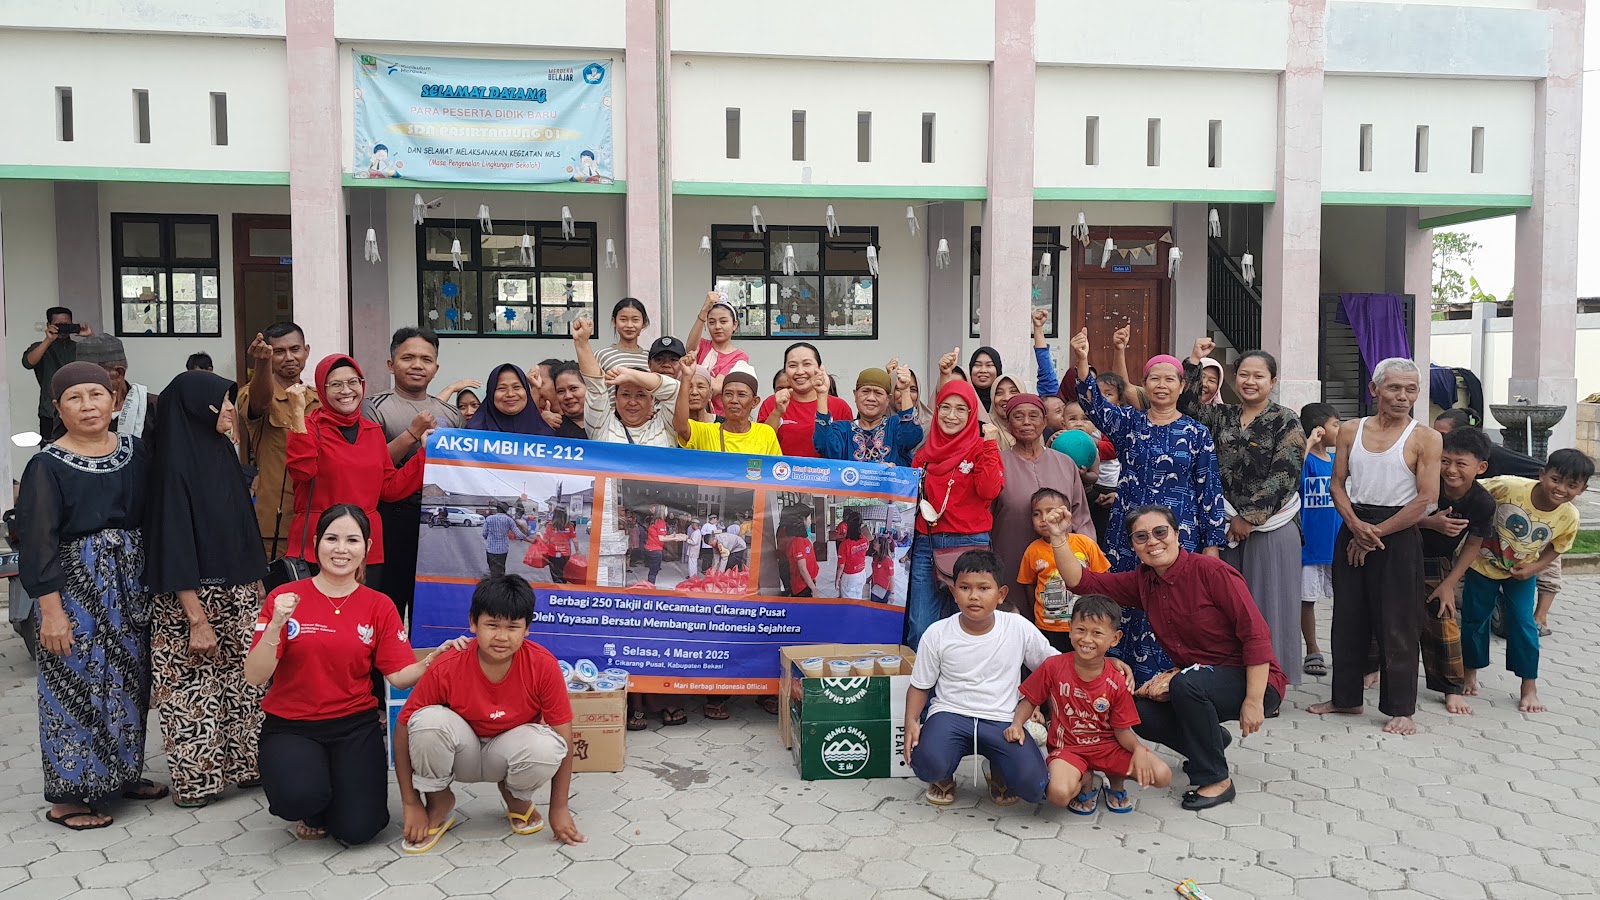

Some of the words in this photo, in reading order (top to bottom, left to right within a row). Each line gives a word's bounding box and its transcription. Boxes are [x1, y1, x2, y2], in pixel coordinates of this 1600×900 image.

[548, 74, 574, 82] BELAJAR
[421, 84, 485, 99] SELAMAT
[489, 86, 547, 103] DATANG
[410, 107, 440, 116] PARA
[442, 108, 493, 118] PESERTA
[495, 109, 524, 119] DIDIK
[527, 110, 557, 119] BARU
[440, 125, 541, 139] PASIRTANJUNG
[423, 147, 453, 155] SELAMAT
[455, 148, 508, 157] MELAKSANAKAN
[509, 149, 543, 158] KEGIATAN
[544, 150, 561, 158] MPLS
[428, 158, 446, 167] (Masa
[448, 159, 480, 168] Pengenalan
[481, 160, 514, 169] Lingkungan
[515, 161, 541, 169] Sekolah)
[435, 435, 478, 453] AKSI
[483, 438, 519, 456] MBI
[523, 442, 585, 461] KE-212
[792, 472, 831, 482] Indonesia
[1305, 477, 1331, 494] MY
[549, 595, 590, 609] Berbagi
[591, 597, 612, 608] 250
[614, 598, 641, 612] Takjil
[643, 600, 653, 610] di
[655, 601, 711, 613] Kecamatan
[713, 604, 757, 617] Cikarang
[759, 607, 786, 617] Pusat
[532, 612, 555, 622] Oleh
[557, 613, 599, 626] Yayasan
[601, 615, 641, 627] Bersatu
[643, 617, 706, 631] Membangun
[709, 621, 756, 633] Indonesia
[757, 623, 801, 635] Sejahtera
[622, 646, 661, 658] Selasa,
[663, 648, 671, 657] 4
[673, 648, 703, 659] Maret
[705, 650, 730, 660] 2025
[615, 660, 644, 668] Cikarang
[667, 661, 702, 670] Kabupaten
[703, 662, 724, 670] Bekasi
[823, 688, 844, 705] SHAN
[845, 688, 868, 705] WANG
[1059, 681, 1071, 698] 10
[824, 726, 847, 742] WANG
[847, 726, 867, 742] SHAN
[895, 726, 905, 756] PEAR
